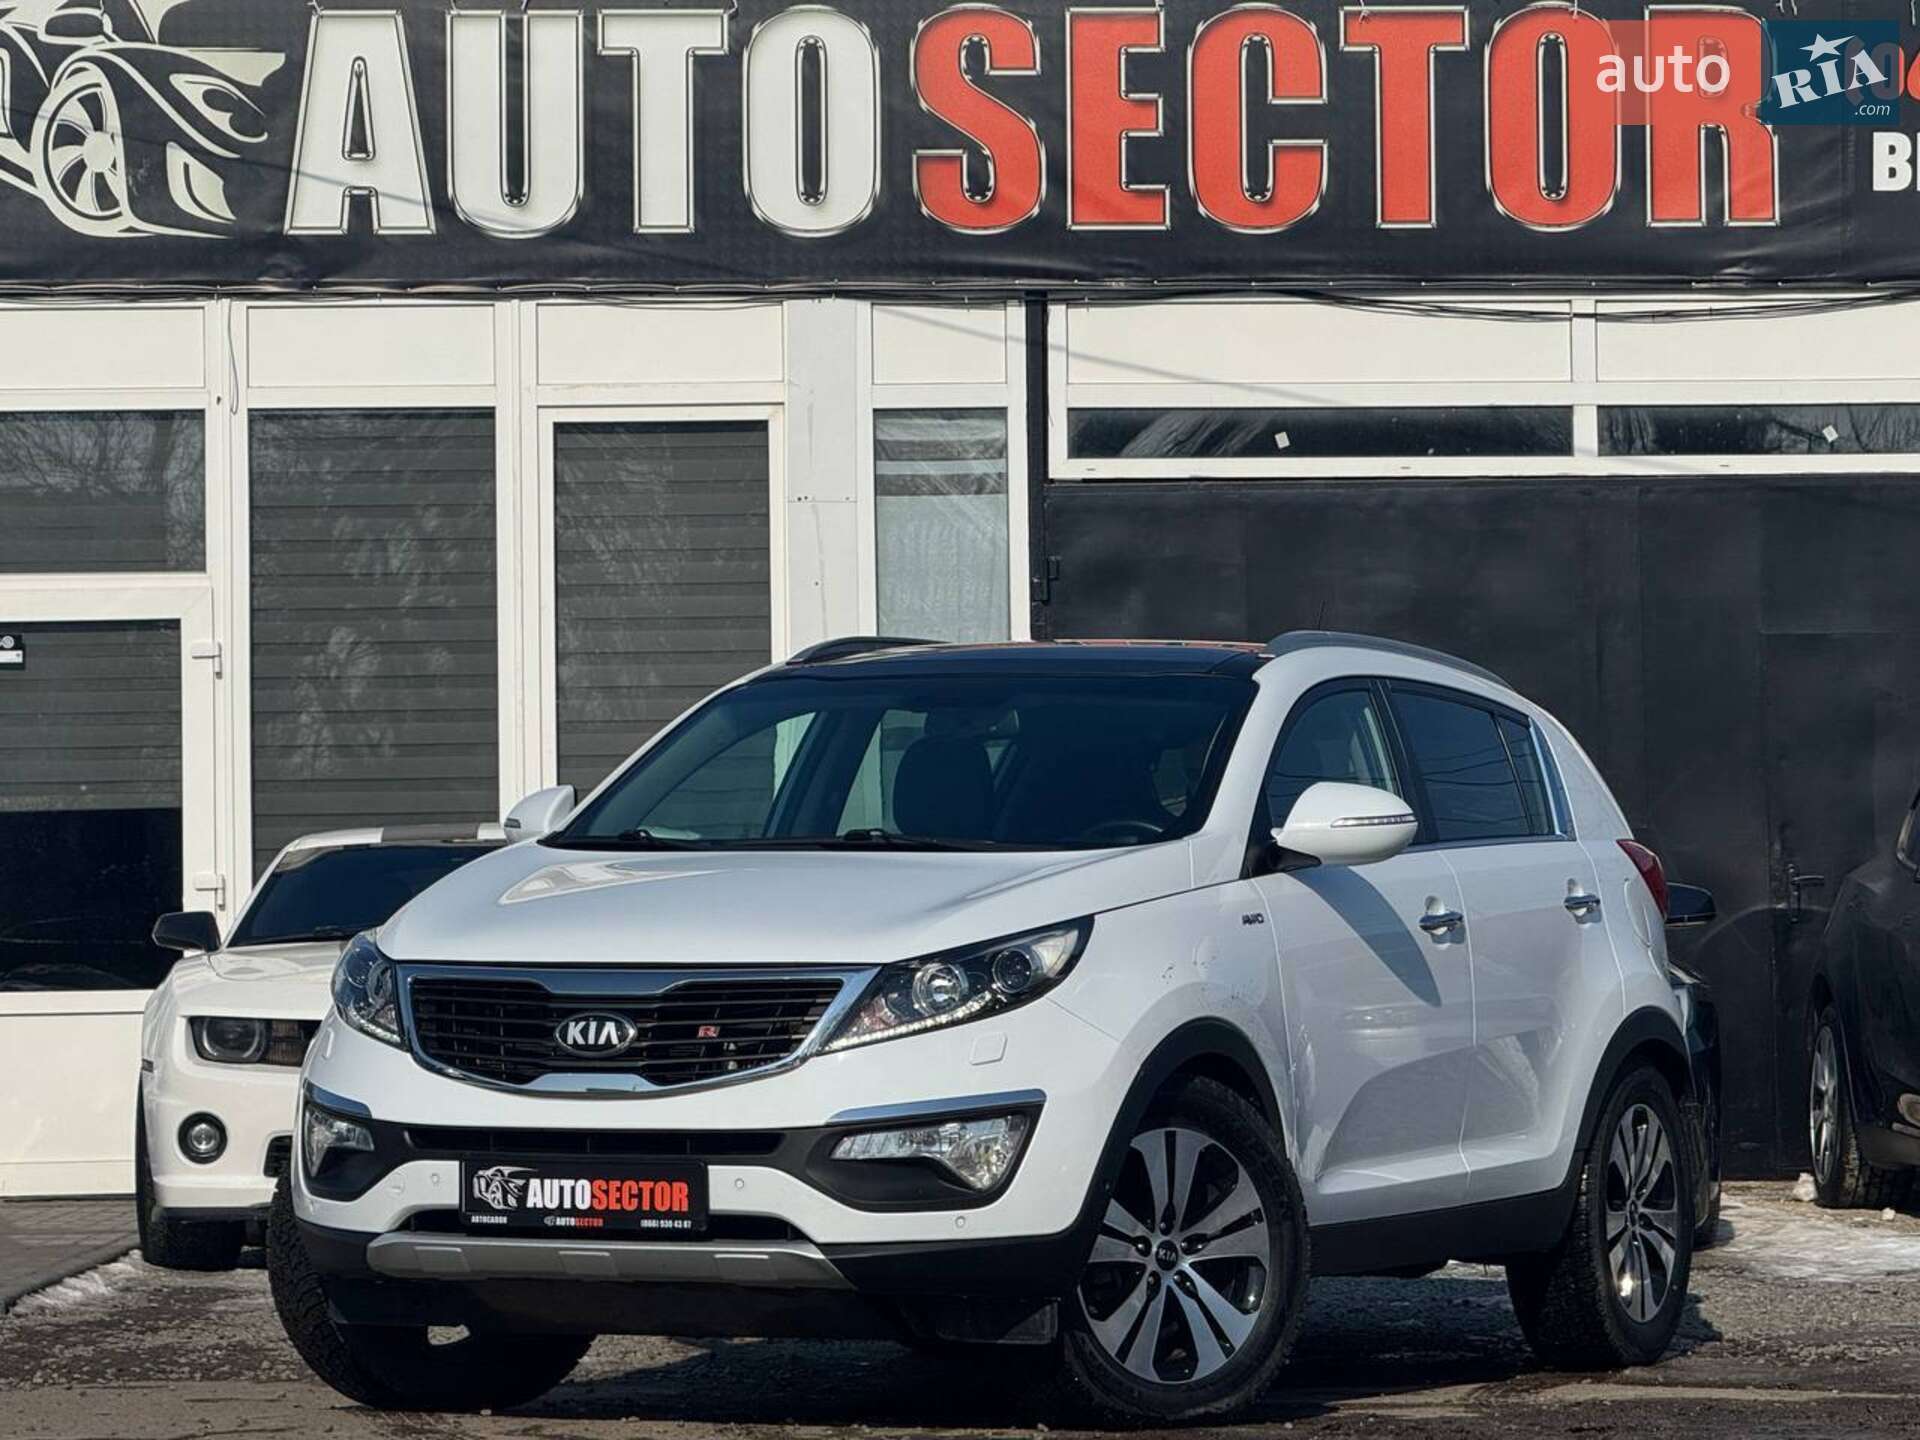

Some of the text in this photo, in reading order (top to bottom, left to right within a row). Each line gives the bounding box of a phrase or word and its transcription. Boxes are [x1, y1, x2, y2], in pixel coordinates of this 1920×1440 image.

[283, 2, 1781, 240] AUTOSECTOR
[567, 1020, 620, 1045] KIA
[526, 1178, 689, 1212] AUTOSECTOR
